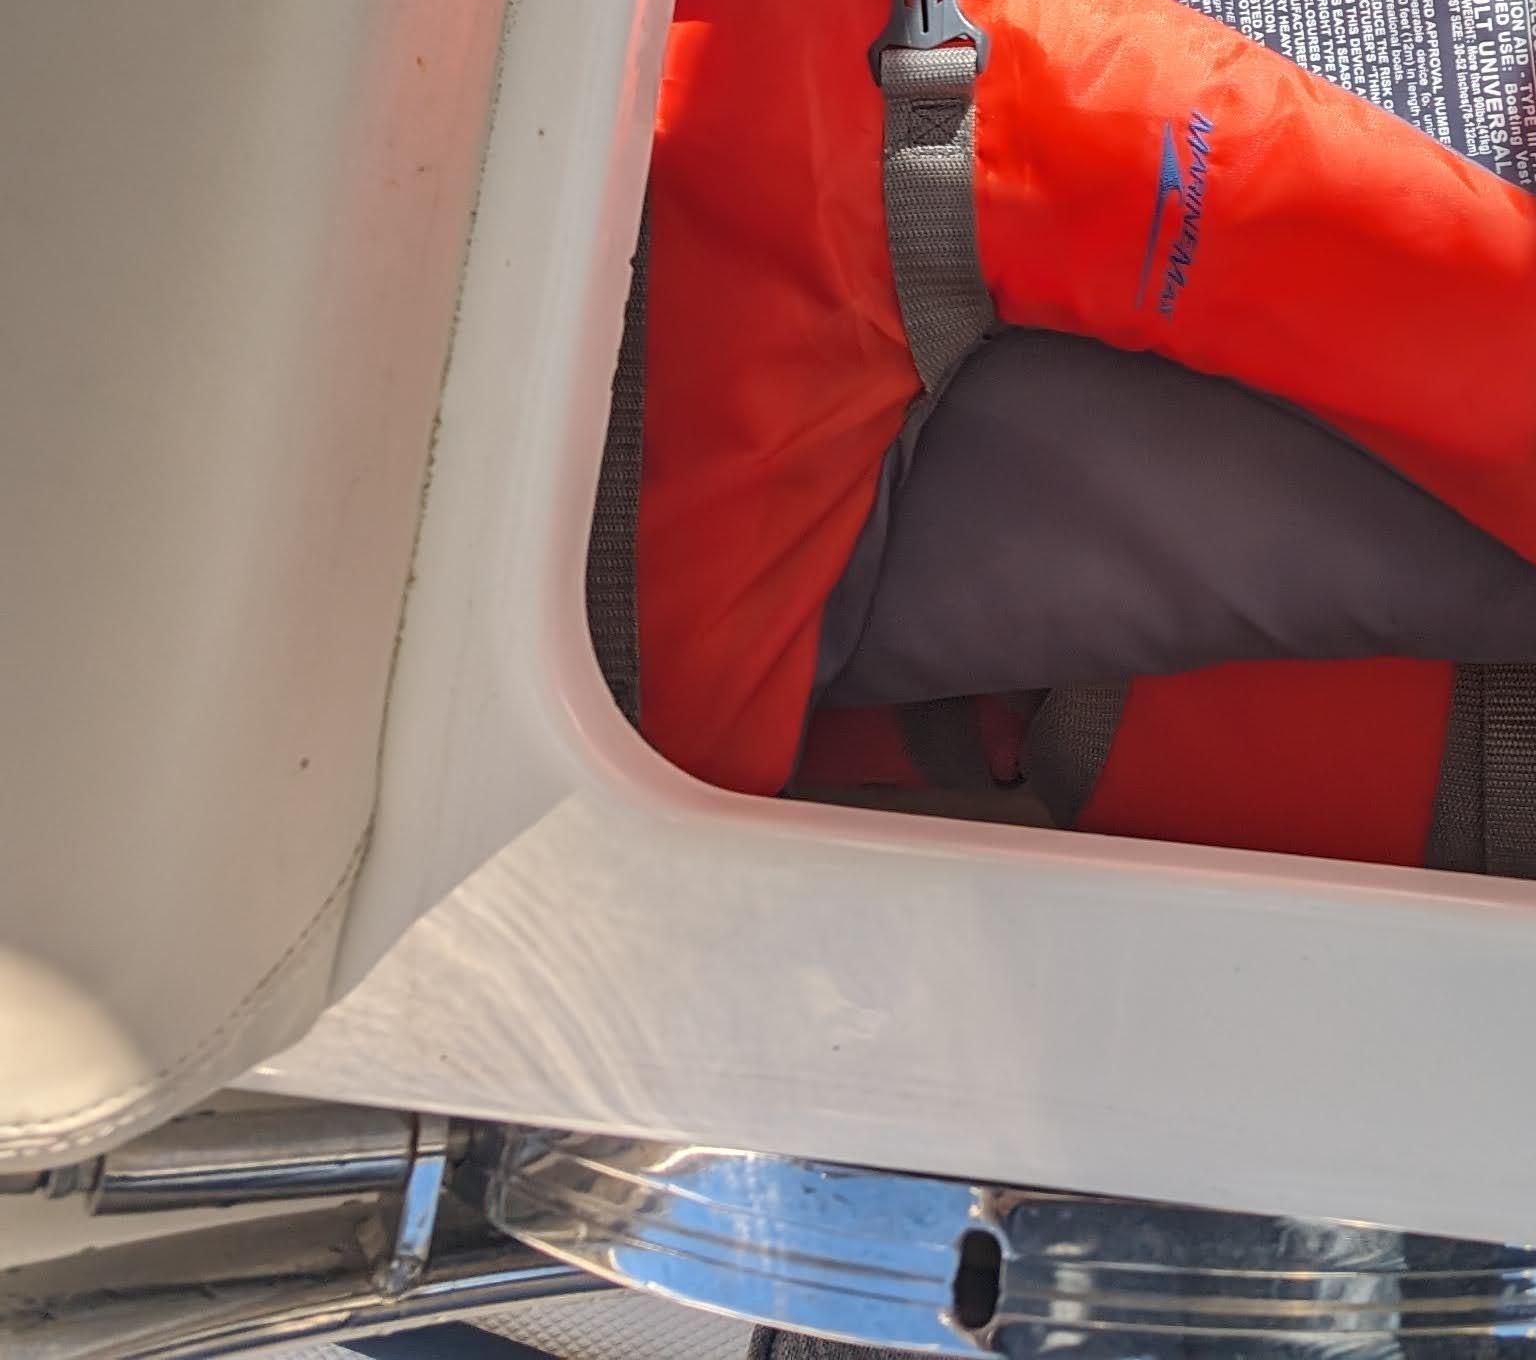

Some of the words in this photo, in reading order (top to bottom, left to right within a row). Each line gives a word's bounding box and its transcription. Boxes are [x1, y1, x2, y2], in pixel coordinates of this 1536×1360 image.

[1225, 1, 1235, 23] THE
[1333, 9, 1346, 44] EACH
[1346, 6, 1359, 34] THIS
[1400, 8, 1411, 29] feet
[1451, 15, 1463, 41] SIZE:
[1461, 0, 1474, 44] WEIGHT:
[1280, 15, 1292, 56] HEAVY
[1378, 33, 1387, 64] THE
[1401, 32, 1415, 65] (12m)
[1498, 32, 1512, 71] USE:
[1515, 37, 1529, 65] AID
[1323, 39, 1336, 71] TYPE
[1350, 38, 1365, 84] DEVICE
[1393, 50, 1403, 84] boats.
[1417, 49, 1428, 85] device
[1423, 21, 1444, 93] APPROVAL
[1467, 45, 1478, 70] More
[1380, 67, 1393, 96] RISK
[1406, 68, 1416, 79] in
[1470, 73, 1482, 95] than
[1405, 82, 1421, 116] length
[1478, 41, 1512, 175] UNIVERSAL
[1504, 83, 1525, 146] Boating
[1515, 151, 1532, 185] Vest
